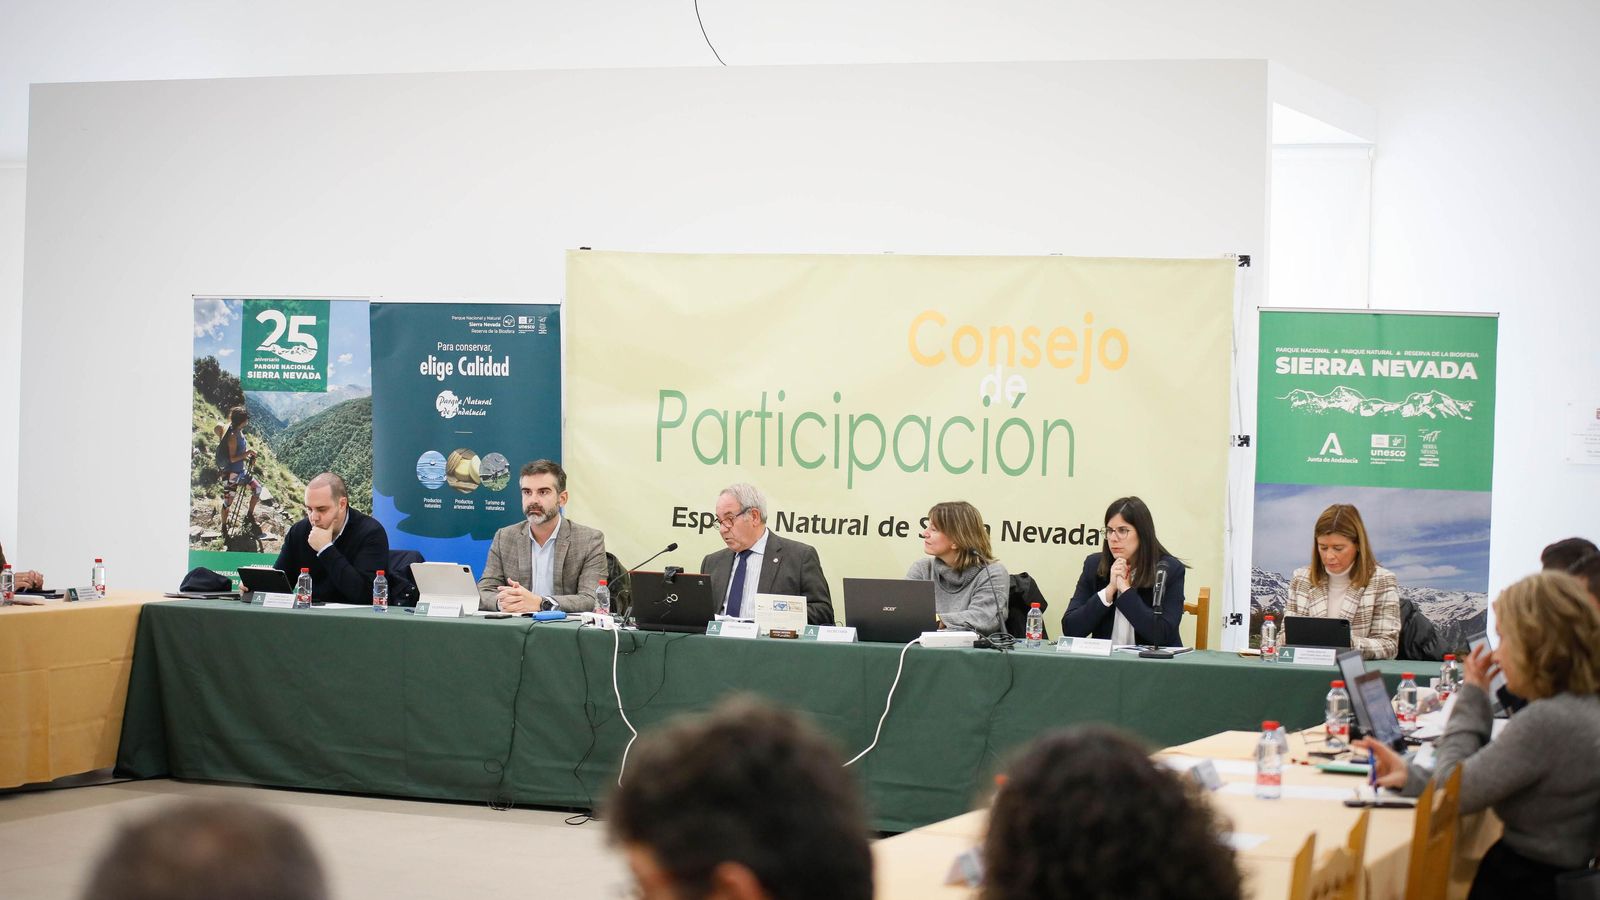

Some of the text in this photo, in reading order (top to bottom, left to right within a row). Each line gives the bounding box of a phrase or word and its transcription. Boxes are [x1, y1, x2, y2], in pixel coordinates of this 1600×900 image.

[256, 309, 319, 363] 25
[438, 342, 492, 352] Para conservar,
[908, 310, 1129, 384] Consejo
[420, 354, 510, 381] elige Calidad
[979, 364, 1028, 404] de
[1276, 356, 1478, 380] SIERRA NEVADA
[463, 396, 492, 406] Natural
[656, 389, 1076, 490] Participación
[775, 511, 868, 536] Natural
[878, 516, 910, 538] de
[1001, 520, 1100, 546] Nevada
